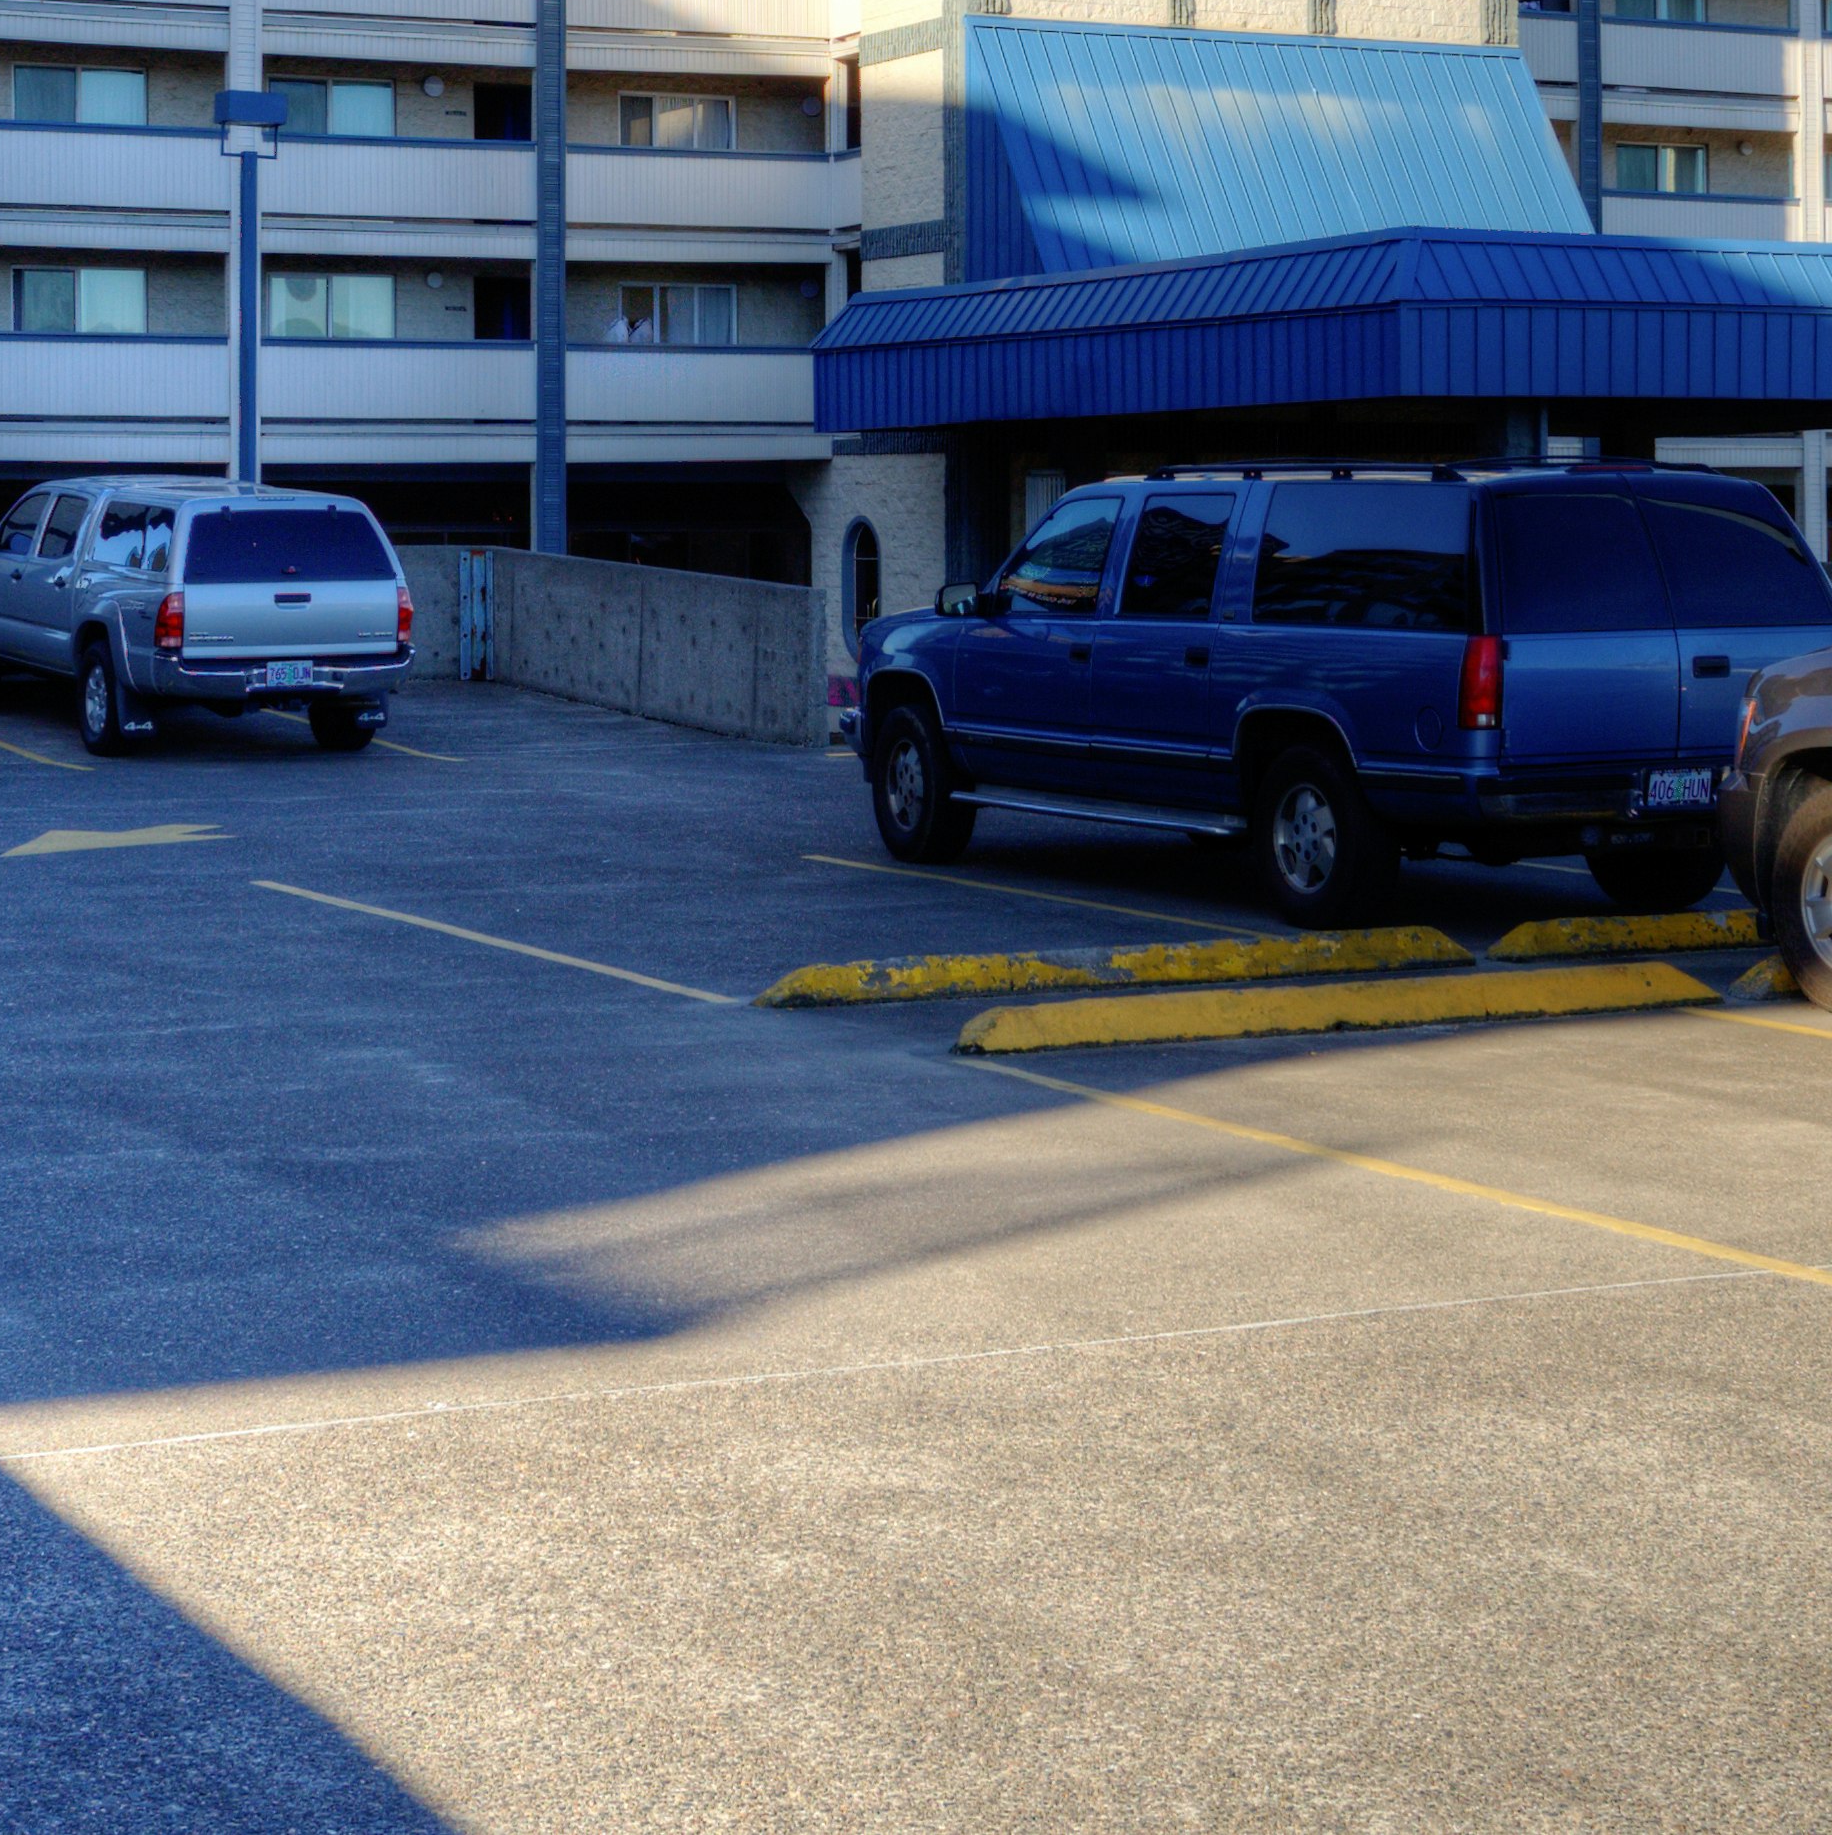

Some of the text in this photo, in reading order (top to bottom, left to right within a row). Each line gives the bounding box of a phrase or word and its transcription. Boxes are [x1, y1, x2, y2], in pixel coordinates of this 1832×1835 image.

[269, 667, 287, 681] 765
[1649, 777, 1709, 800] 406 HUN
